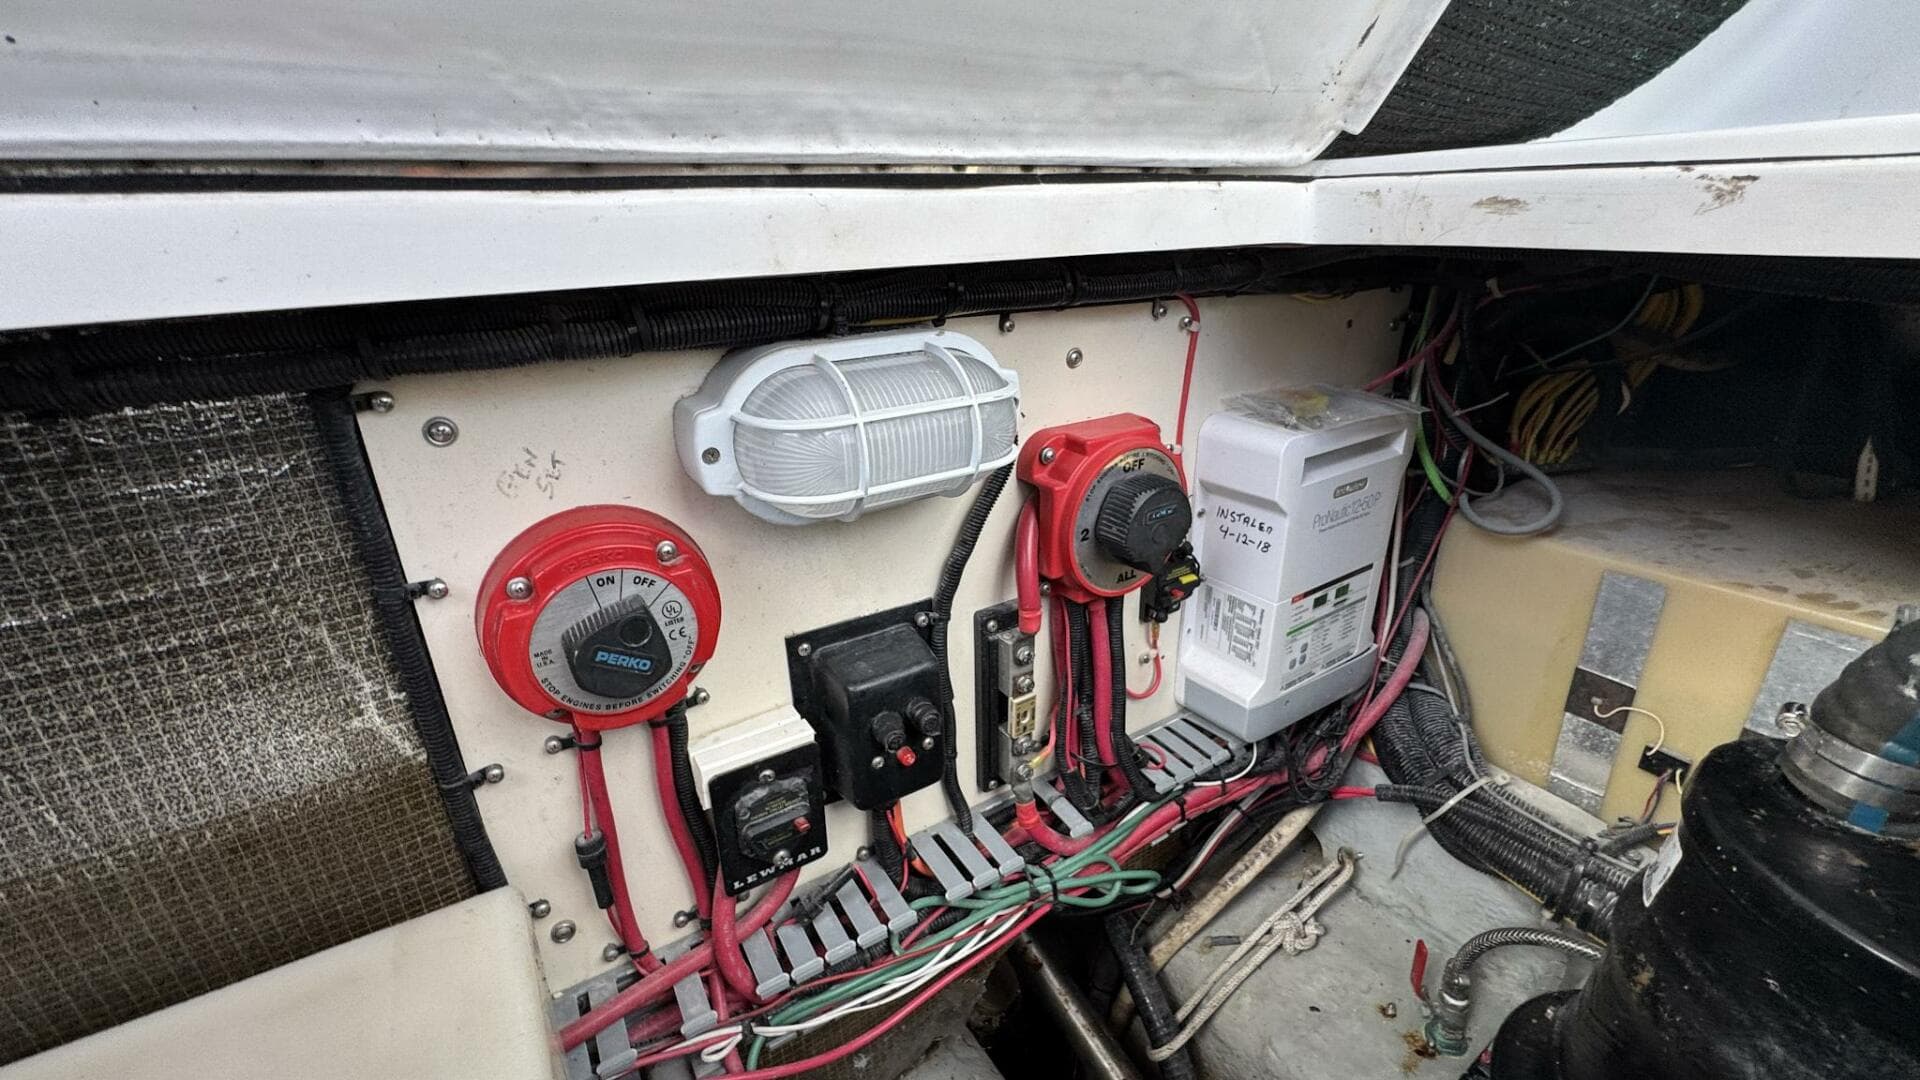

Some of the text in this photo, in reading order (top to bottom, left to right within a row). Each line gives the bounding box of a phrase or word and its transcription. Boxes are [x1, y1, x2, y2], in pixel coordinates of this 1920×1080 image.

[1122, 458, 1146, 473] OFF
[1079, 528, 1090, 542] 2
[1219, 525, 1272, 554] 4-12-18
[596, 575, 616, 588] ON
[632, 575, 657, 589] OFF
[1115, 569, 1138, 584] ALL
[594, 650, 653, 672] PERKO
[541, 678, 562, 700] STOP
[561, 694, 602, 712] ENGINES
[605, 695, 645, 711] BEFORE
[646, 661, 687, 700] SWITCHING
[732, 846, 822, 890] LEWMAR
